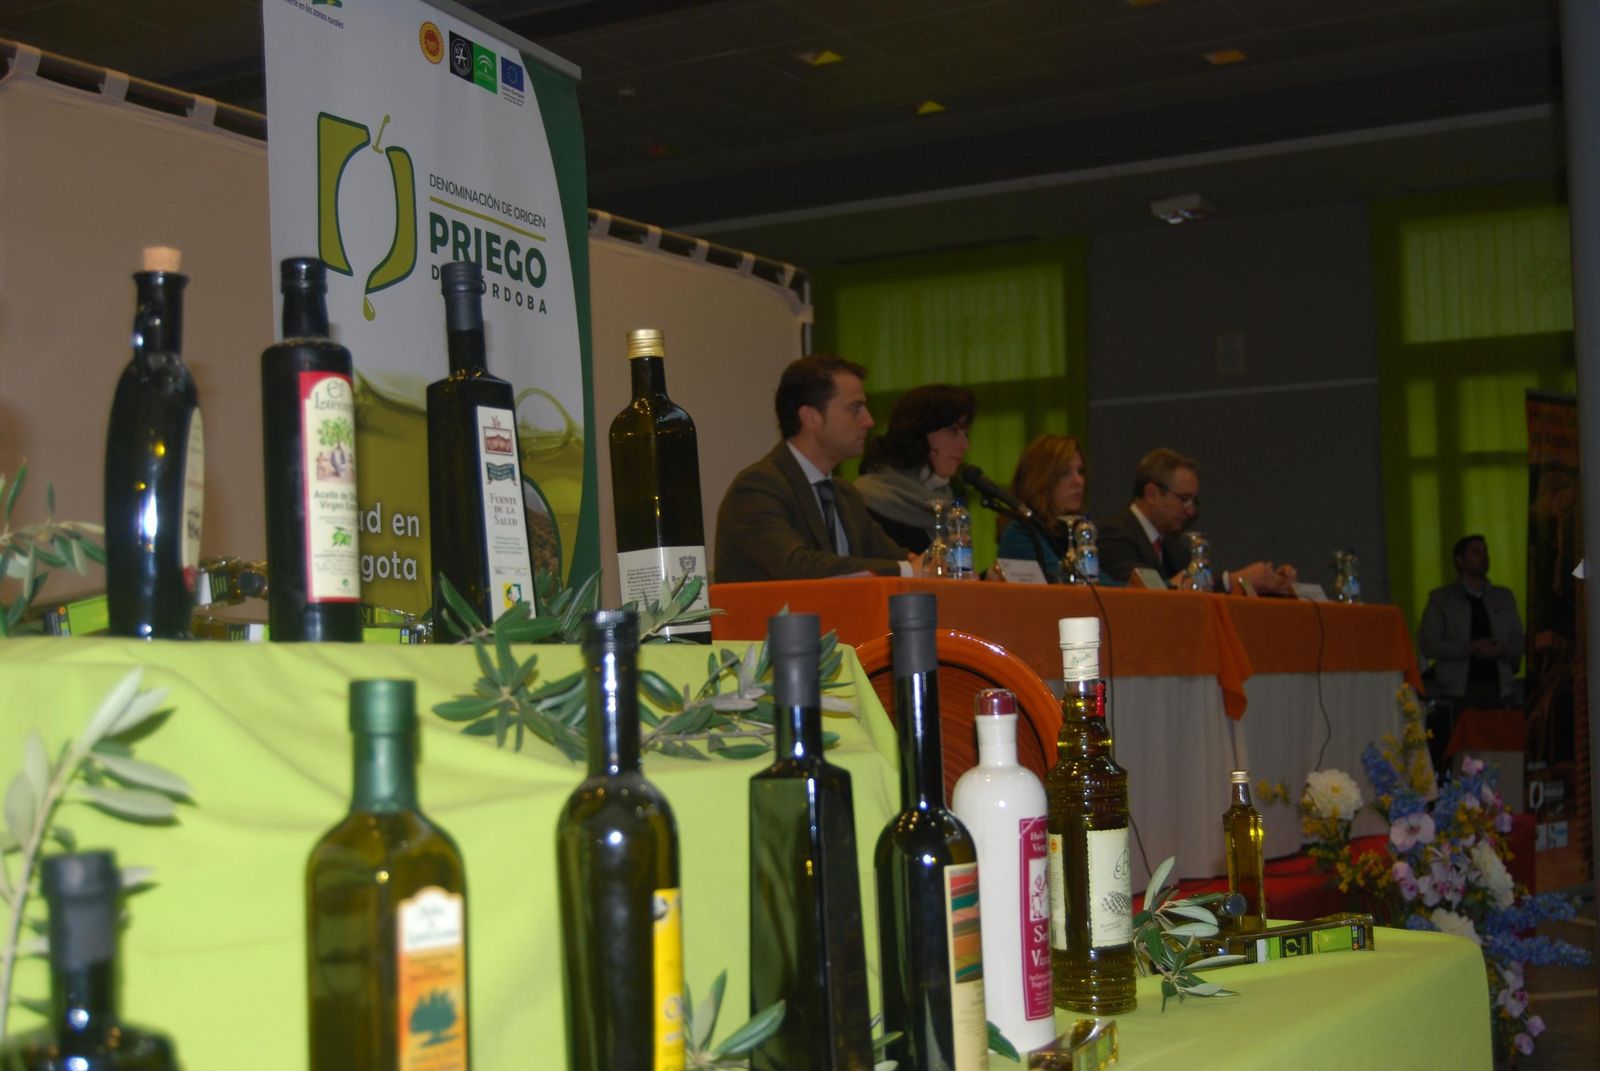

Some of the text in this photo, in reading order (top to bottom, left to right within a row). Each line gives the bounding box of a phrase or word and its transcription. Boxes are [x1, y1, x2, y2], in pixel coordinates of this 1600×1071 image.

[313, 8, 328, 22] zonas
[327, 16, 344, 29] rurales
[429, 173, 546, 229] DENOMINACIÓN DE ORIGEN
[429, 211, 547, 288] PRIEGO
[320, 500, 344, 512] Virgen
[490, 492, 518, 505] FUENTE
[494, 513, 518, 527] SALUD
[506, 506, 515, 514] LA
[392, 513, 420, 538] en
[360, 550, 417, 583] gota
